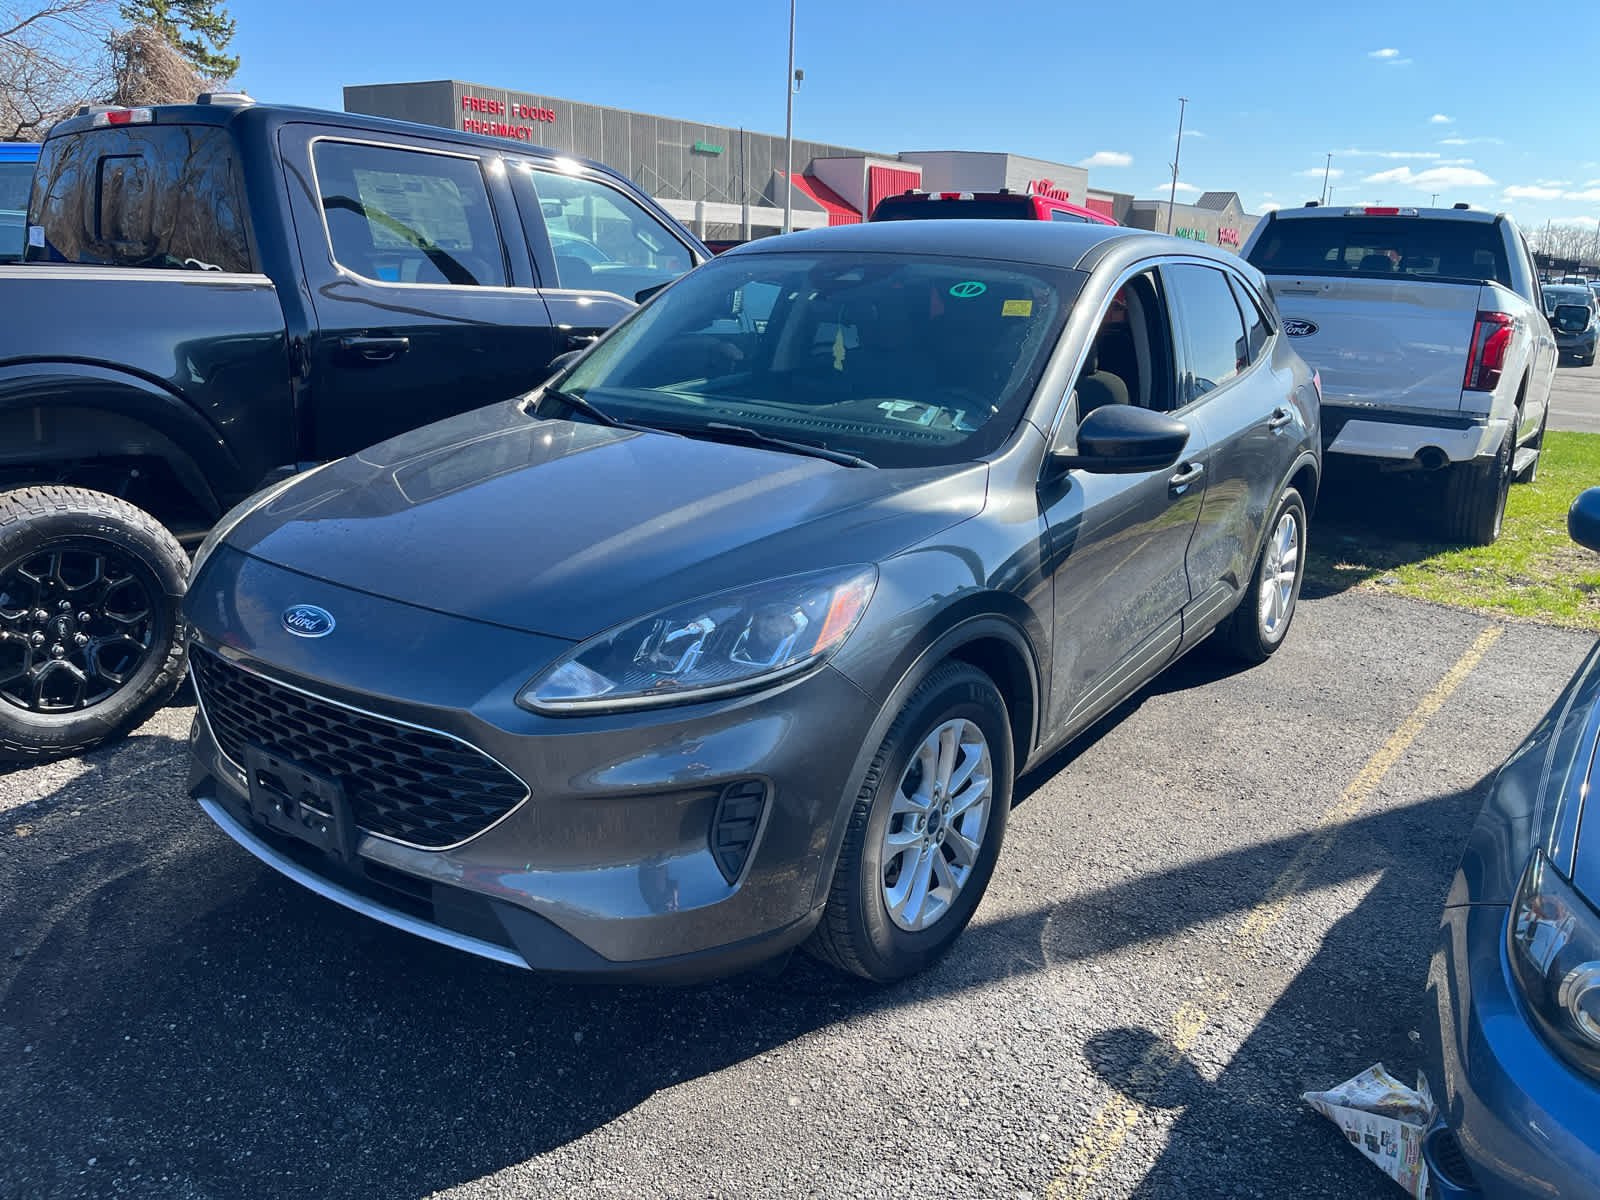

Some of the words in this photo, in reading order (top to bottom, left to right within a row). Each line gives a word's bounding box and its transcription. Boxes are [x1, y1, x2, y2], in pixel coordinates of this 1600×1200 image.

[462, 95, 505, 115] FRESH
[512, 103, 556, 123] FOODS
[463, 117, 533, 140] PHARMACY
[286, 607, 324, 632] Ford
